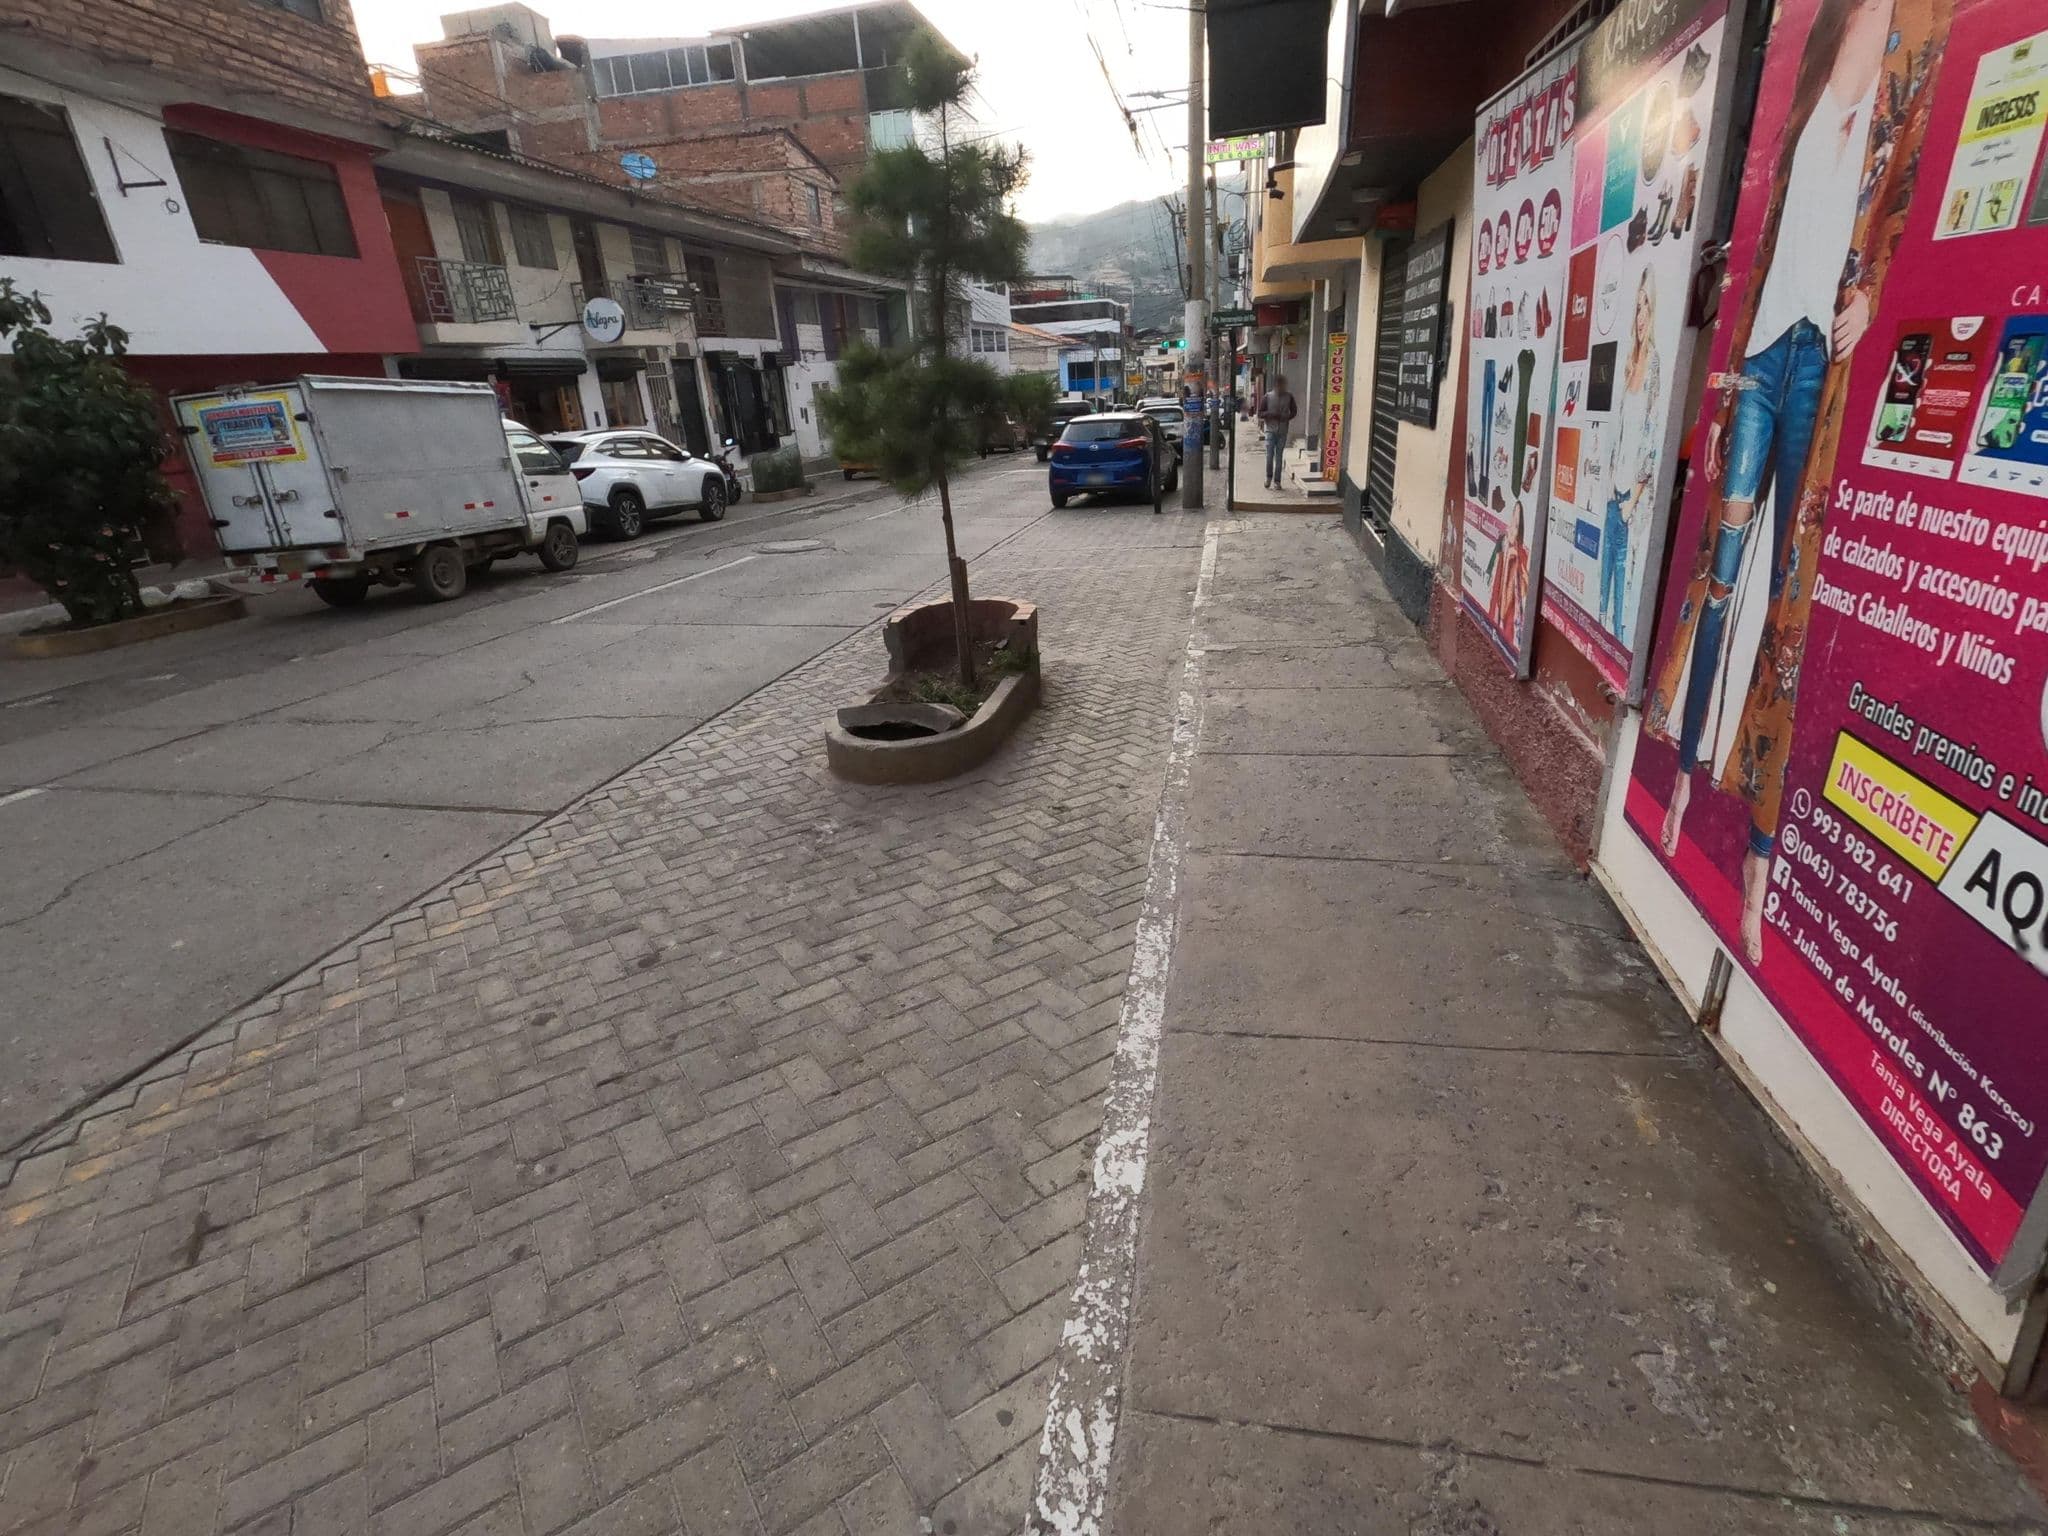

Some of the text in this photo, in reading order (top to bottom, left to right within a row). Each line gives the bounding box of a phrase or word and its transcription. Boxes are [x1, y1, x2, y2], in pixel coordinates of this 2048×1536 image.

[1602, 0, 1668, 69] KARO
[1209, 143, 1231, 154] INTI
[1488, 81, 1575, 174] OFERTAS
[1976, 90, 2041, 131] INGRESOS
[2011, 284, 2048, 307] CA
[1331, 347, 1345, 394] JUGOS
[1327, 403, 1341, 466] BATIDOS
[1834, 478, 1853, 511] Se
[1851, 489, 1894, 522] parte
[1895, 490, 1918, 528] de
[1918, 505, 1990, 546] nuestro
[1823, 526, 1842, 559] de
[1842, 534, 1905, 581] calzados
[1901, 559, 1920, 593] y
[1918, 564, 2019, 620] accesorios
[1811, 573, 2016, 685] Damas Caballeros y Niños
[1848, 681, 1915, 742] Grandes
[1912, 725, 1997, 789] premios
[1998, 772, 2016, 801] e
[1811, 807, 1914, 904] 993 982 641
[1837, 761, 1955, 865] INSCRÍBETE
[1797, 841, 1899, 943] (043) 783756
[1962, 847, 2048, 953] AQ
[1776, 910, 1792, 937] Jr.
[1793, 927, 1835, 981] Julian
[1834, 974, 1856, 1004] de
[1856, 994, 1926, 1080] Morales
[1957, 1102, 2005, 1160] 863
[1790, 877, 2036, 1139] Tania Vega Ayala (distribución Karoca)
[1869, 1049, 1994, 1201] Tania Vega Ayala
[1880, 1095, 1963, 1202] DIRECTORA
